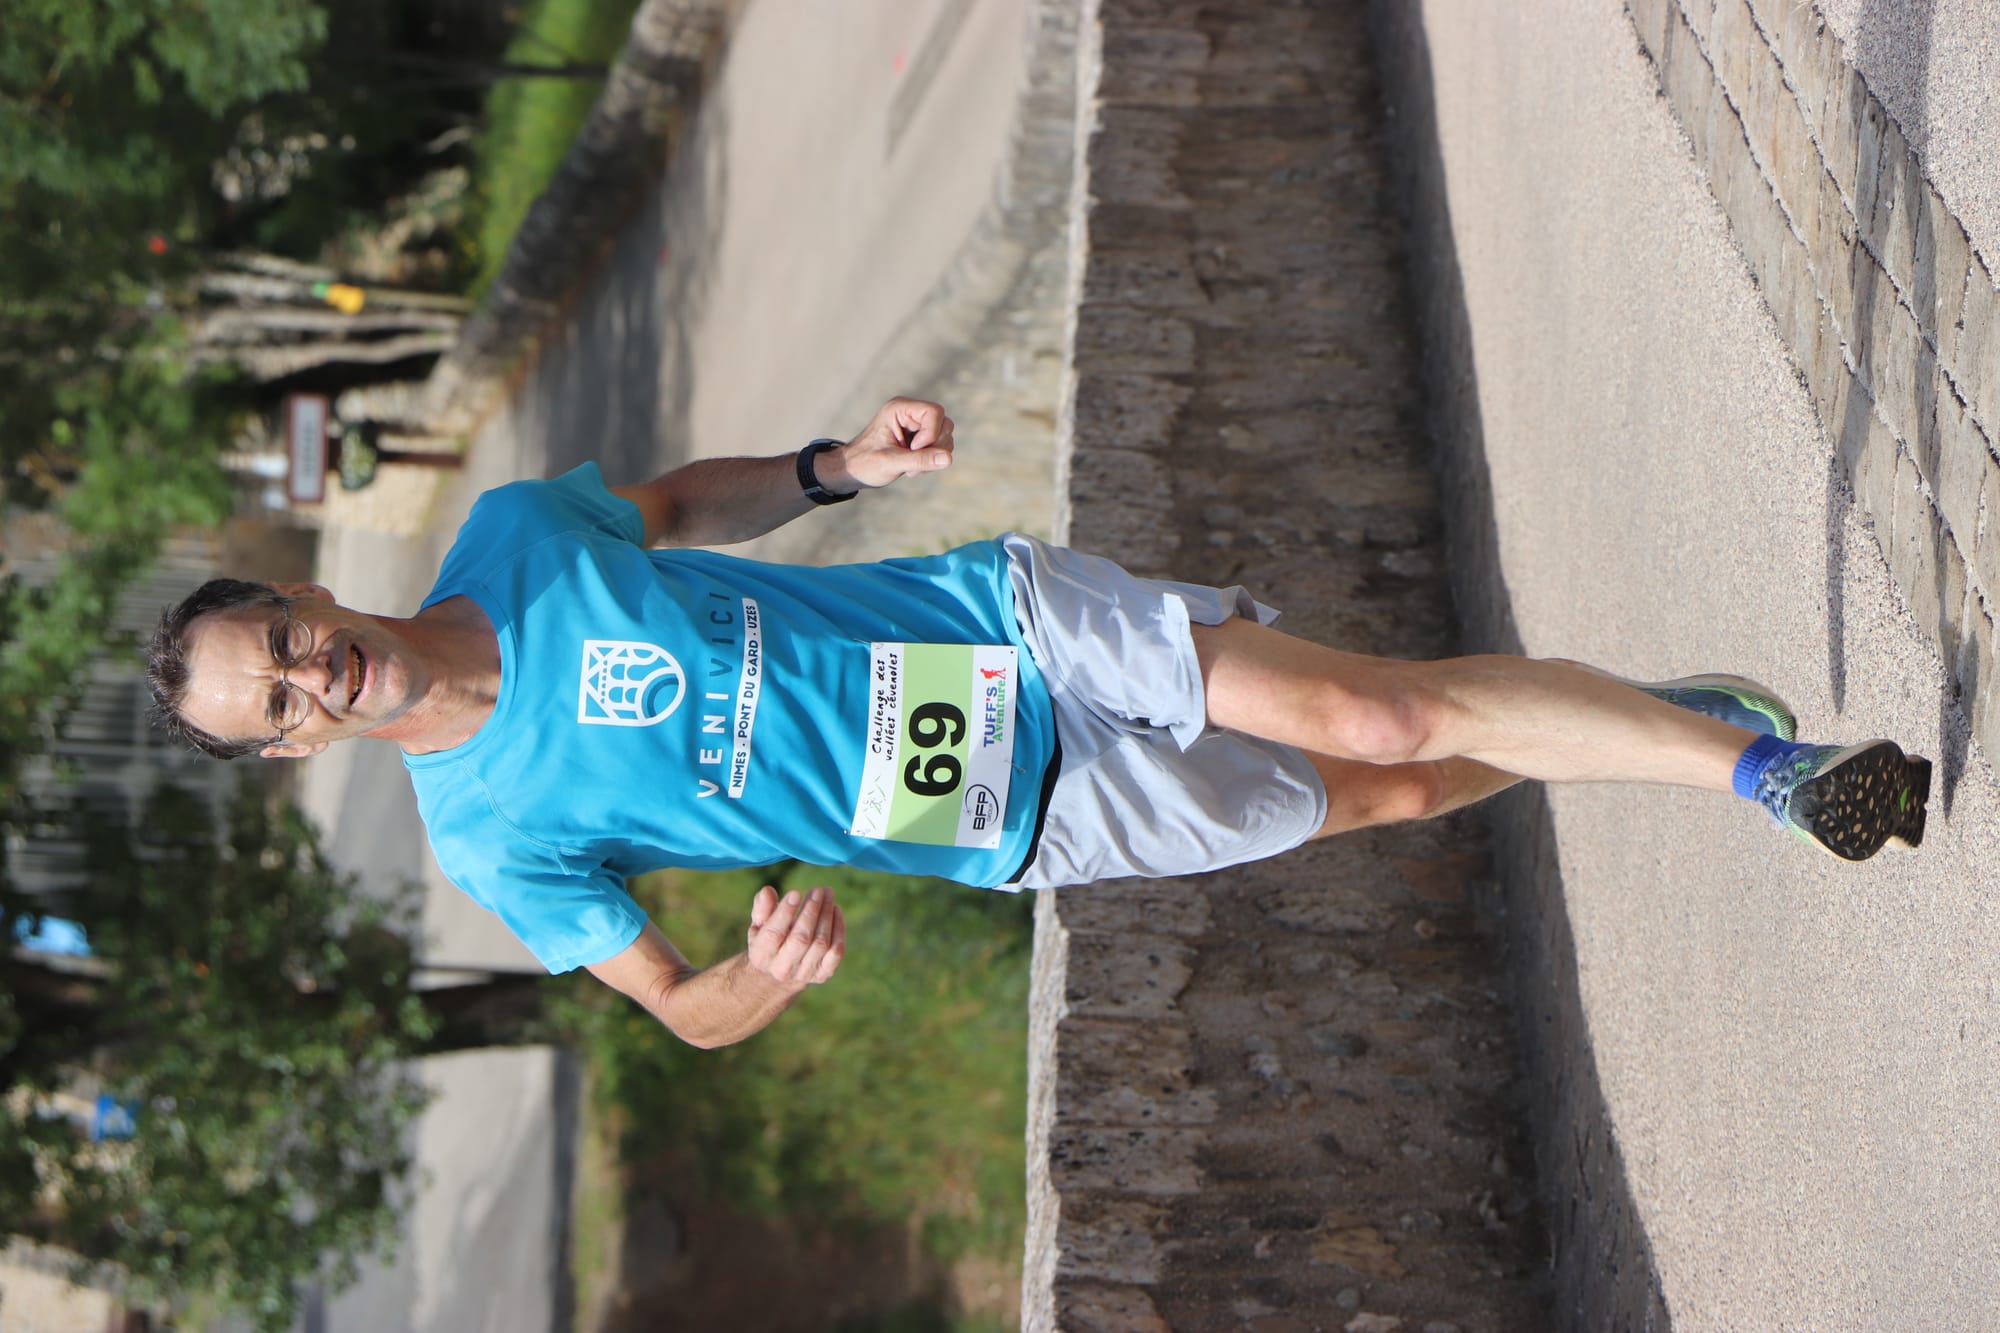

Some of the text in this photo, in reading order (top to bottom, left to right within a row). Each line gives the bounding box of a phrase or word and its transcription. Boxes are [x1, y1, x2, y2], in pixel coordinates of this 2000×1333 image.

[746, 604, 758, 629] UZES
[747, 639, 759, 677] GARD
[743, 681, 756, 699] DU
[871, 659, 888, 754] Challenge des
[885, 653, 898, 761] vallées cévenoles
[738, 703, 753, 739] PONT
[984, 686, 998, 747] TUFF'S
[993, 680, 1006, 742] Aventure
[904, 702, 967, 797] 69
[733, 751, 747, 788] NIMES
[973, 791, 989, 830] BFP
